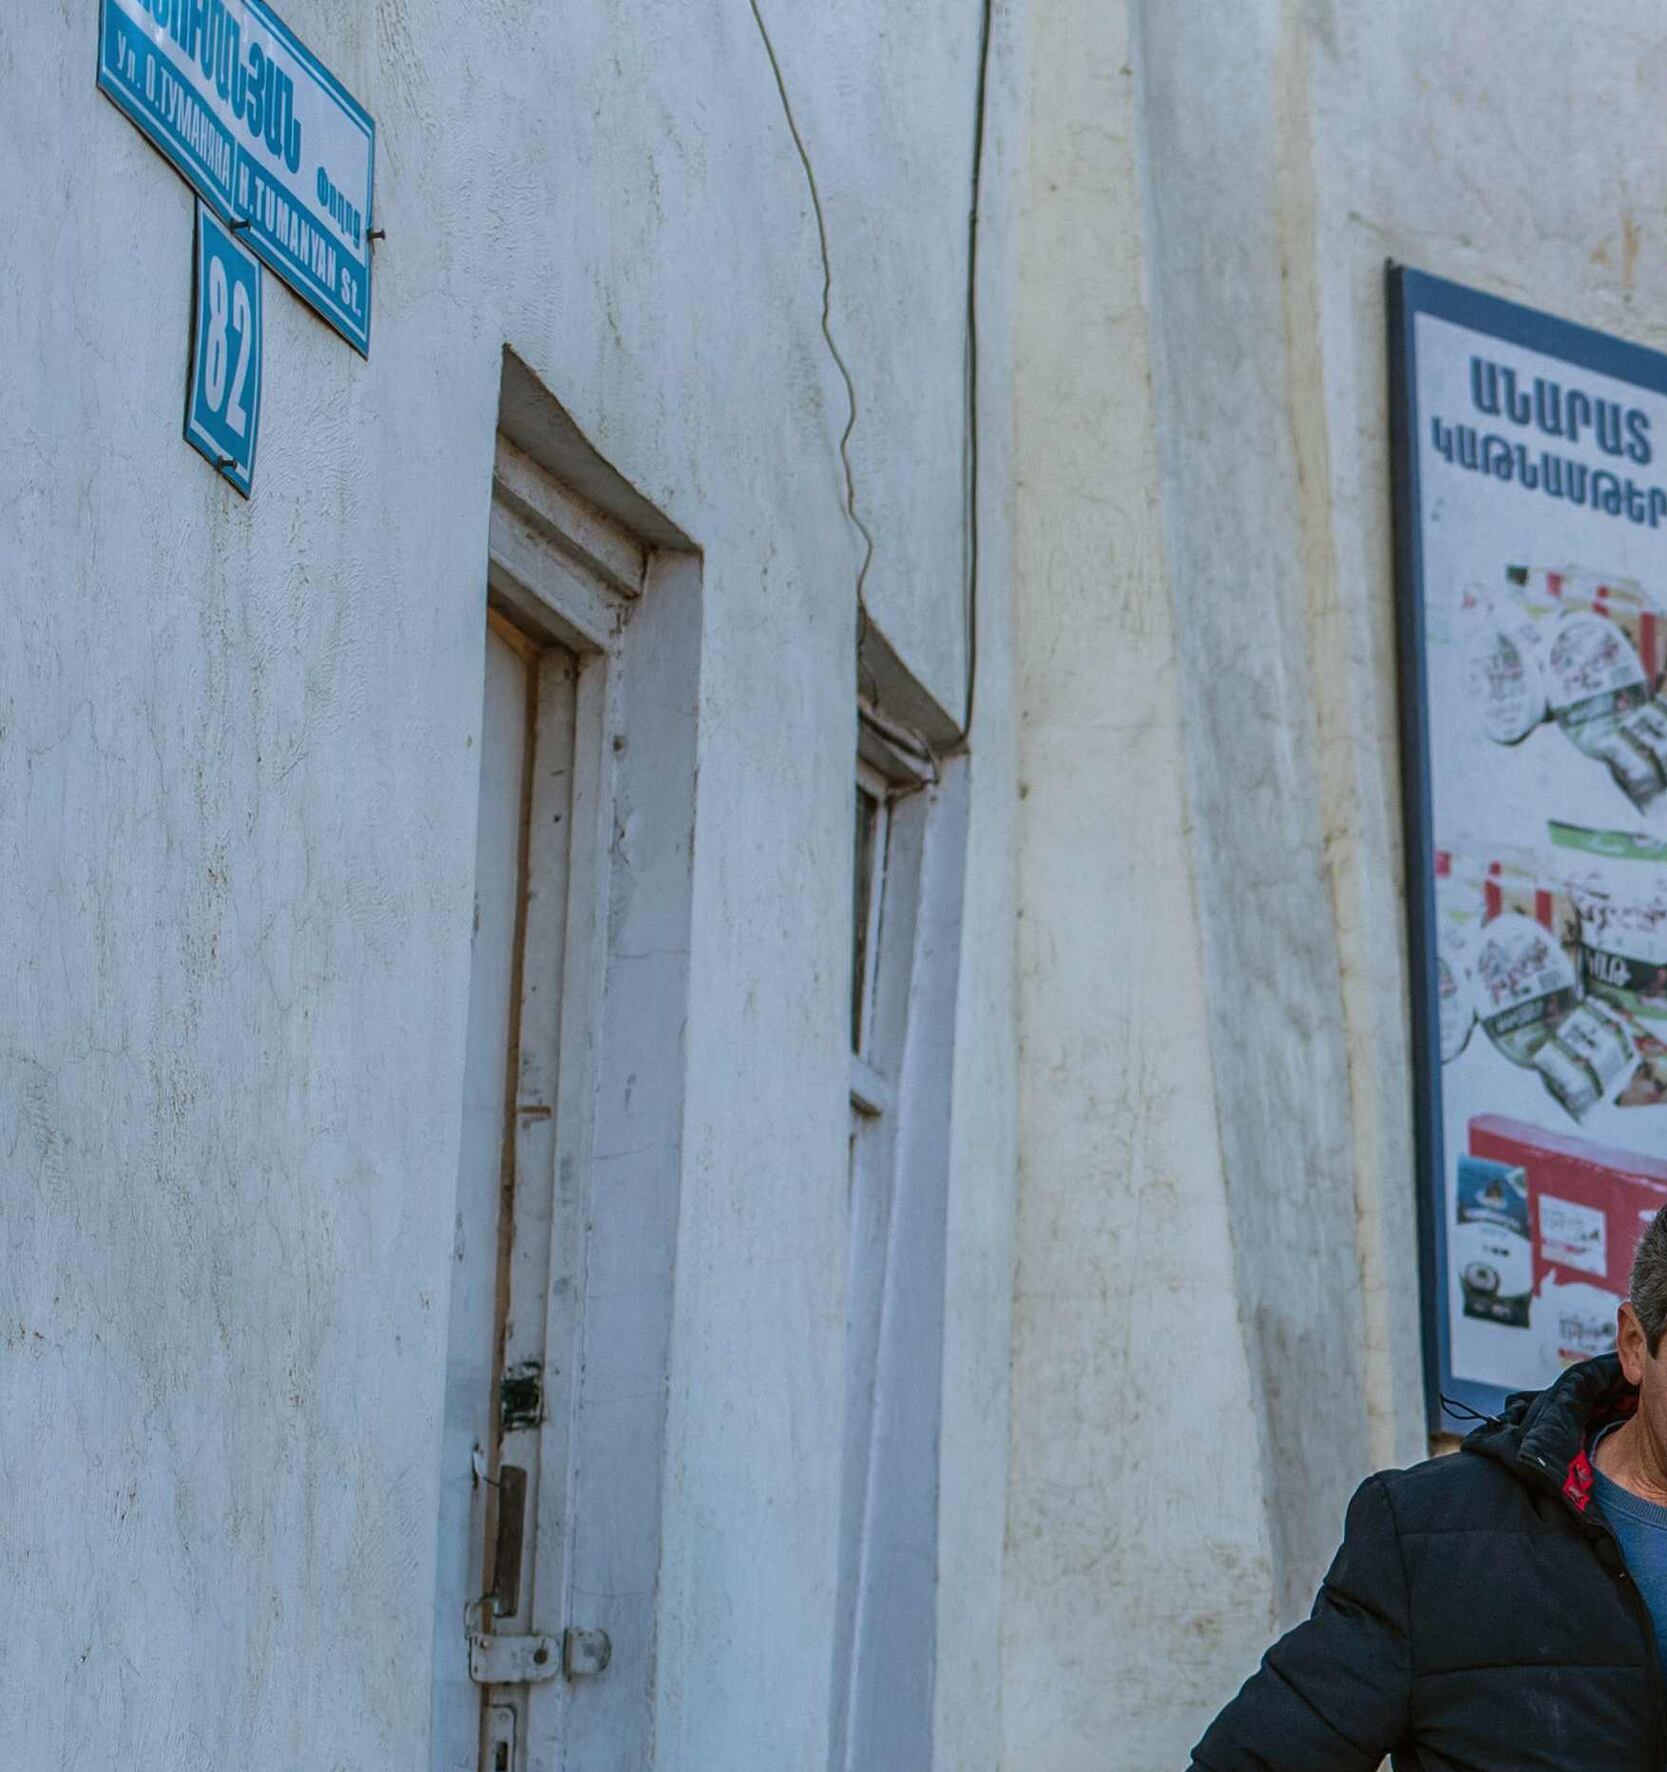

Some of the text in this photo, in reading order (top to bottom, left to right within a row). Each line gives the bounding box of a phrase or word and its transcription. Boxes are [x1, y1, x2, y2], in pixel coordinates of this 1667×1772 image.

[239, 161, 362, 316] H.TUMANYAN St.
[204, 255, 251, 438] 82
[1470, 355, 1653, 467] ԱՆԱՐԱՏ
